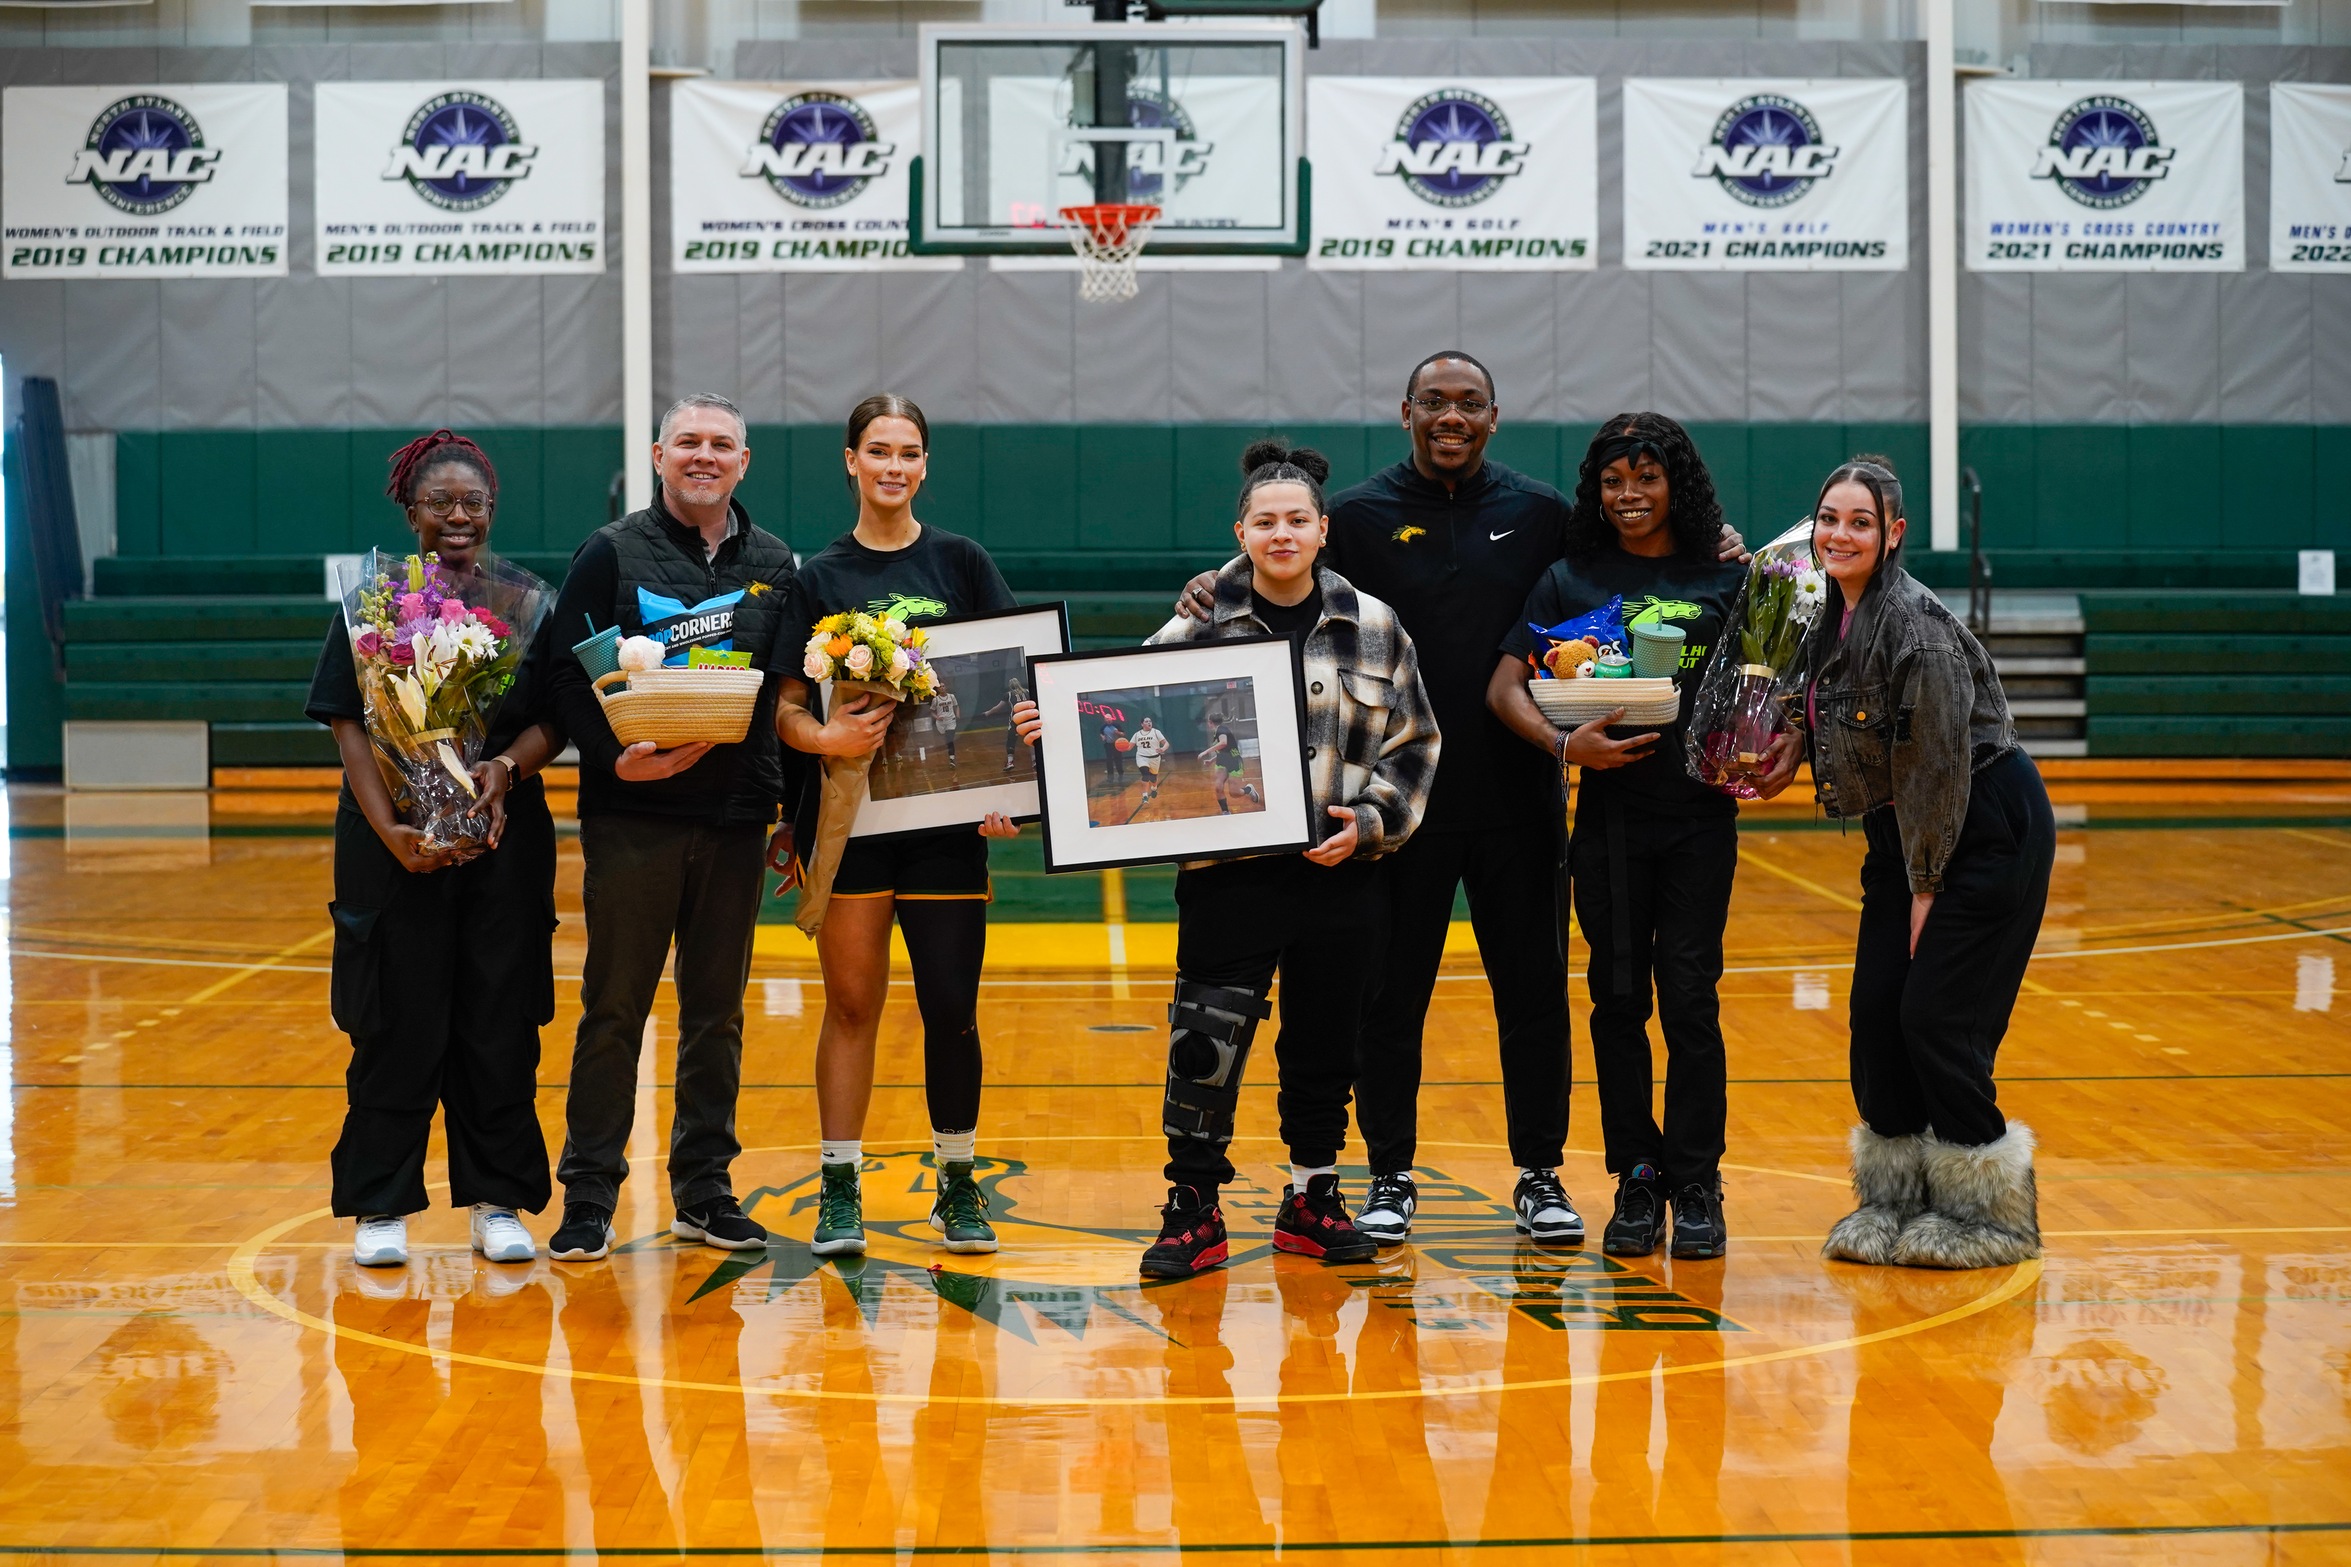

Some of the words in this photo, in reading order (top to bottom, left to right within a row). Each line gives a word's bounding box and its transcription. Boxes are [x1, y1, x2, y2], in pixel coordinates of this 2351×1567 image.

[90, 97, 131, 144] NORTH
[136, 94, 203, 144] ATLANTIC
[65, 148, 222, 184] NAC
[381, 144, 538, 181] NAC
[739, 142, 895, 178] NAC
[1374, 141, 1530, 176] NAC
[1691, 143, 1839, 178] NAC
[2029, 146, 2176, 179] NAC
[5, 226, 79, 239] WOMEN'S
[85, 226, 159, 238] OUTDOOR
[166, 226, 216, 238] TRACK
[224, 225, 235, 237] &
[242, 225, 284, 237] FIELD
[324, 223, 377, 236] MEN'S
[384, 223, 463, 235] OUTDOOR
[471, 223, 524, 235] TRACK
[532, 222, 543, 234] &
[551, 222, 596, 235] FIELD
[701, 220, 783, 232] WOMEN'S
[791, 220, 847, 231] CROSS
[855, 220, 910, 231] COUNT
[1386, 219, 1454, 230] MEN'S
[1467, 218, 1521, 230] GOLF
[1703, 222, 1768, 234] MEN'S
[1782, 222, 1830, 234] GOLF
[1990, 222, 2070, 236] WOMEN'S
[2083, 221, 2135, 236] CROSS
[2145, 222, 2221, 236] COUNTRY
[2289, 225, 2337, 239] MEN'S
[11, 247, 87, 266] 2019
[99, 246, 278, 266] CHAMPIONS
[327, 244, 403, 263] 2019
[415, 242, 596, 262] CHAMPIONS
[684, 240, 759, 260] 2019
[772, 240, 911, 258] CHAMPIO
[1319, 239, 1395, 257] 2019
[1406, 239, 1587, 257] CHAMPIONS
[1646, 241, 1711, 258] 2021
[1724, 241, 1886, 258] CHAMPIONS
[1987, 242, 2052, 260] 2021
[2065, 242, 2224, 260] CHAMPIONS
[2291, 245, 2351, 262] 2022
[1680, 645, 1707, 656] LHI
[1140, 741, 1152, 749] 22
